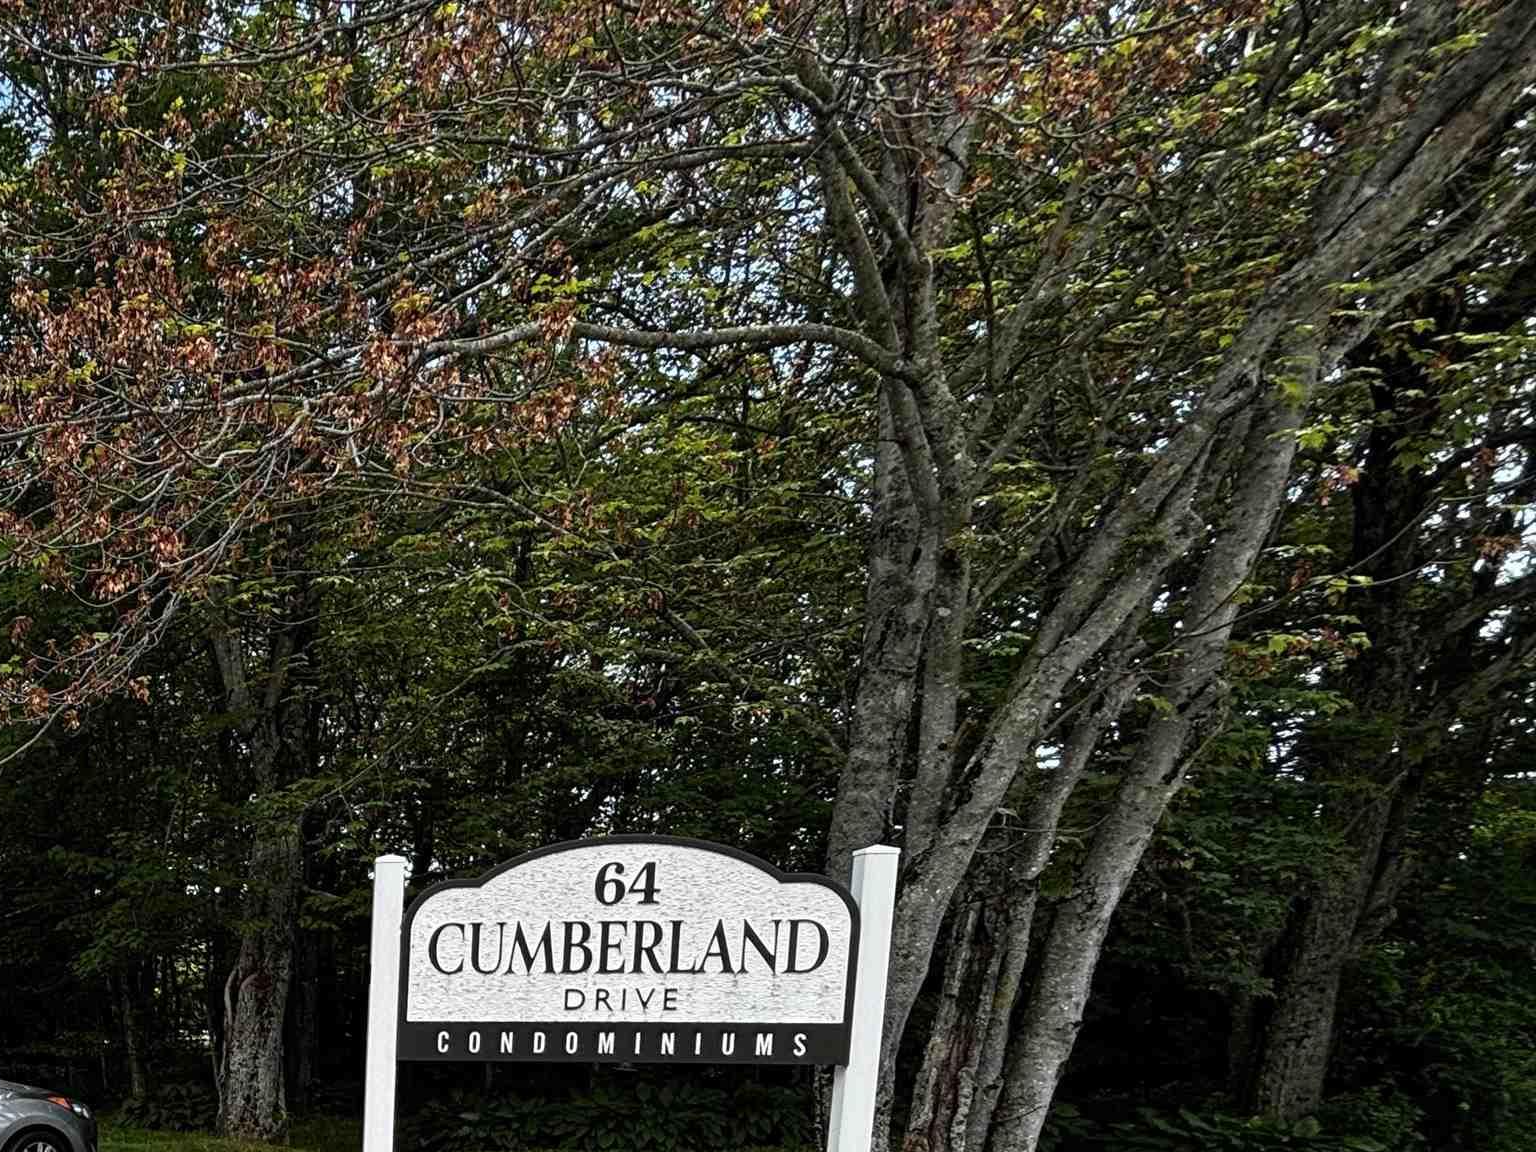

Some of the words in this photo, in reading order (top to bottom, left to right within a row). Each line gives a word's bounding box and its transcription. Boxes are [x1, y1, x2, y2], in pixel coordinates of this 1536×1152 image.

[595, 862, 660, 904] 64
[428, 918, 829, 974] CUMBERLAND
[564, 988, 679, 1010] DRIVE
[438, 1031, 807, 1056] CONDOMINIUMS
